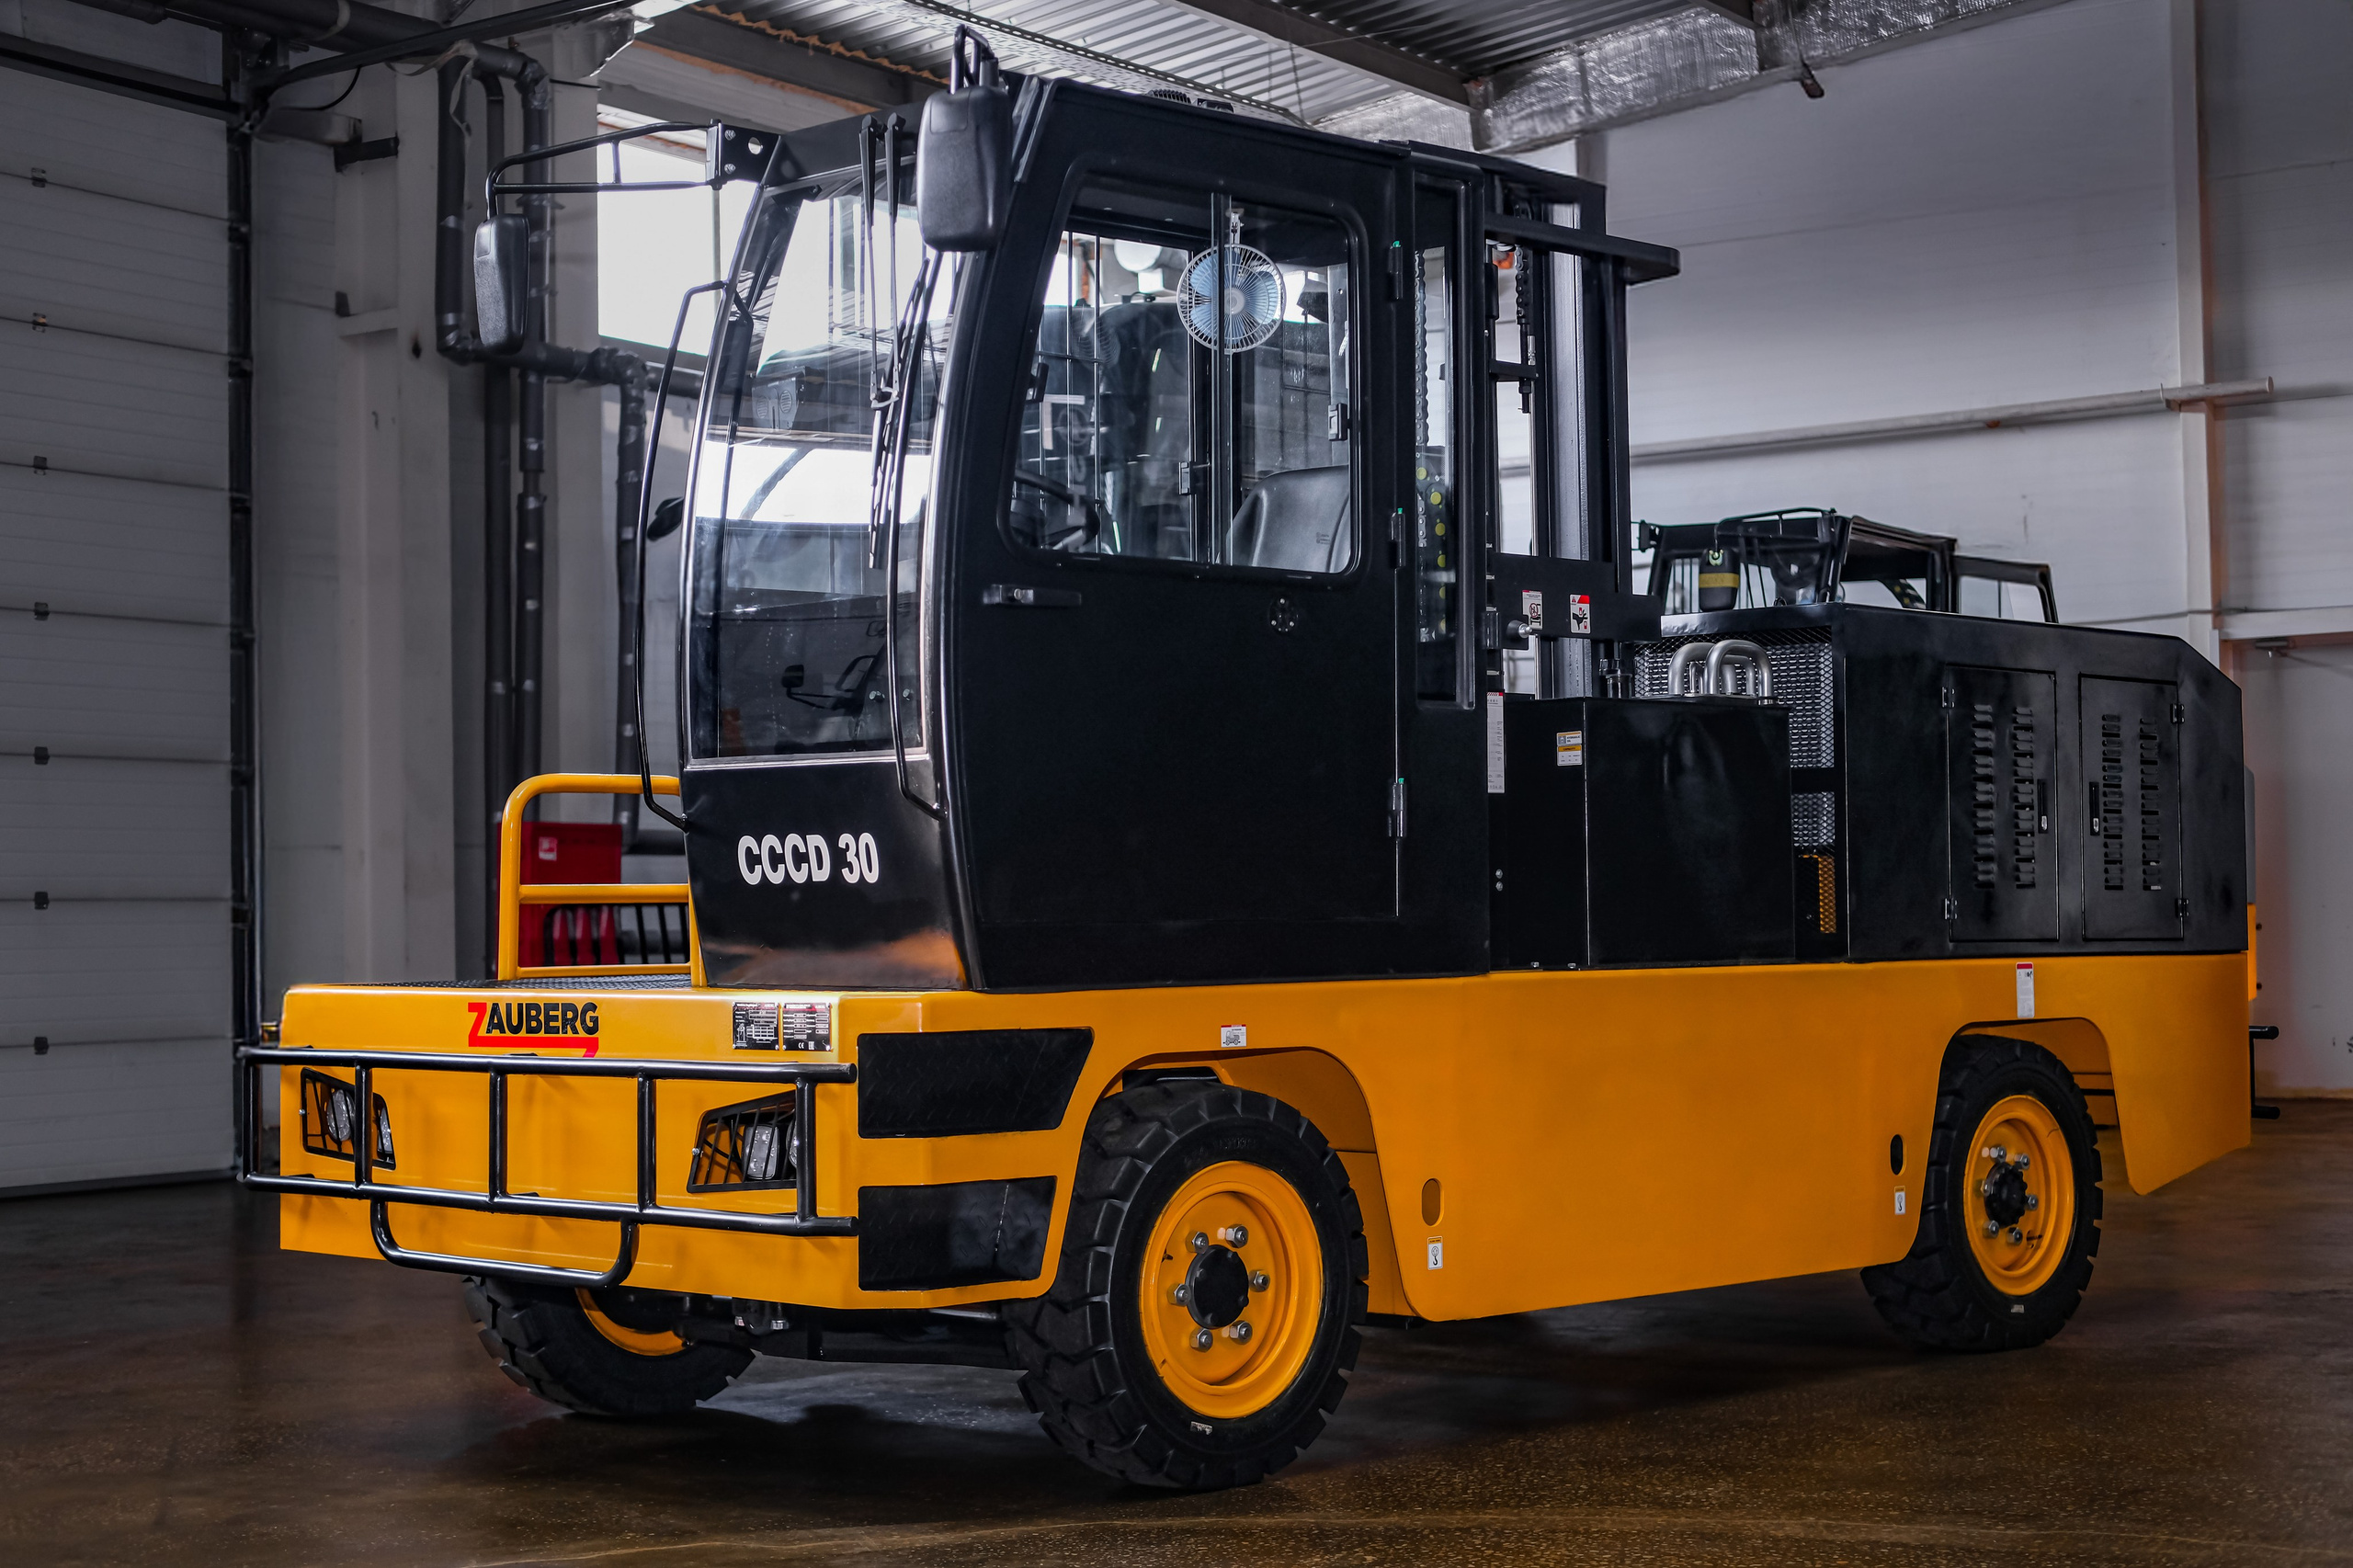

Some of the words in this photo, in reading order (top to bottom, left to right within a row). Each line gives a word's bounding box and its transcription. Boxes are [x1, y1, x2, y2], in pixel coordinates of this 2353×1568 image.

[737, 833, 831, 885] CCCD
[838, 832, 880, 884] 30
[468, 1001, 599, 1047] ZAUBERG
